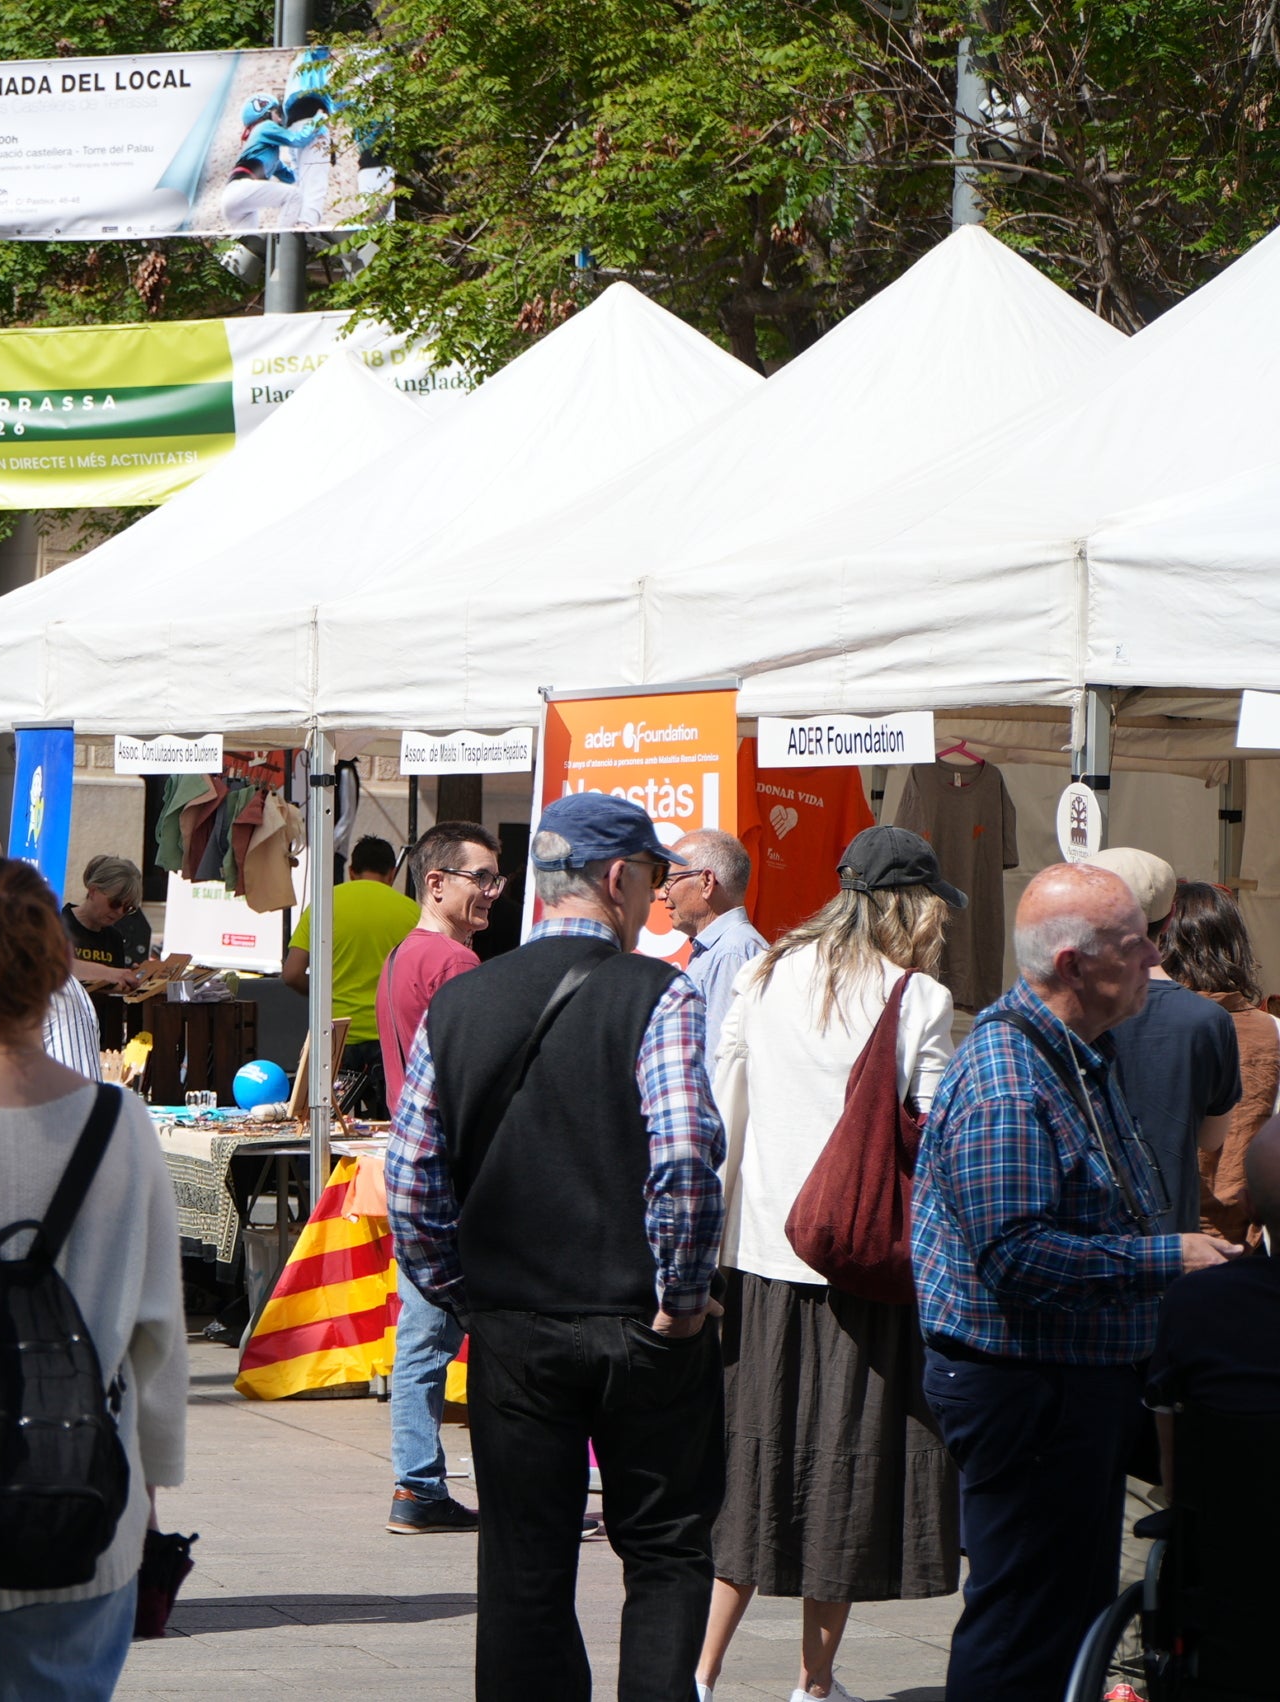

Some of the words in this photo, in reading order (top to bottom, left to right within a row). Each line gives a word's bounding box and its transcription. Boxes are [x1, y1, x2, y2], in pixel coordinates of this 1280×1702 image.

[61, 72, 106, 93] DEL
[114, 69, 191, 90] LOCAL
[25, 146, 73, 158] castellera
[82, 144, 107, 156] Torre
[110, 143, 124, 154] del
[127, 142, 155, 154] Palau
[10, 455, 66, 470] DIRECTE
[78, 450, 107, 469] MÉS
[585, 726, 620, 749] ader
[788, 726, 824, 756] ADER
[827, 723, 905, 755] Foundation
[118, 741, 139, 760] Assoc.
[185, 743, 193, 762] de
[404, 744, 427, 762] Assoc.
[429, 744, 438, 762] de
[756, 782, 795, 801] DONAR
[798, 791, 825, 808] VIDA
